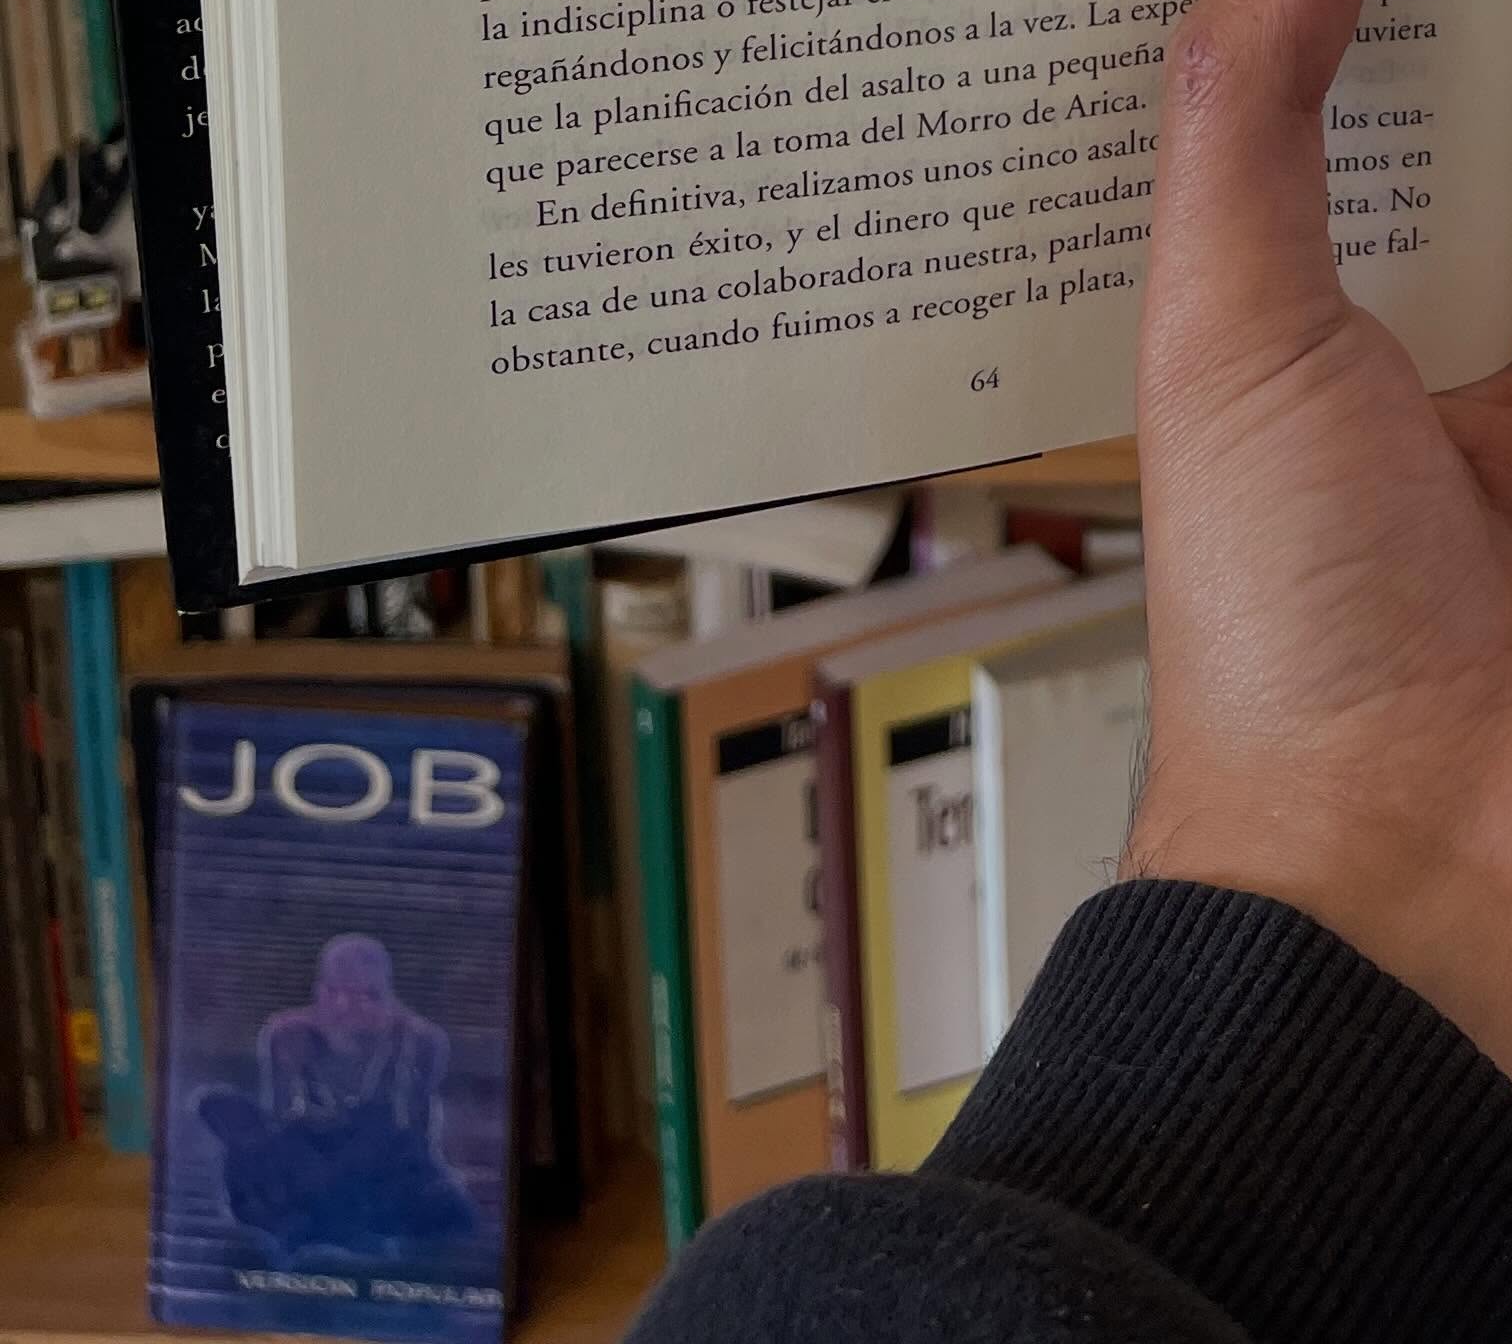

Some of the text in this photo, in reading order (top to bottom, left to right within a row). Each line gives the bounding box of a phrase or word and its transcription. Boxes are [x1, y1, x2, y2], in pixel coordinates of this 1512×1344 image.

[484, 89, 1148, 194] que parecerse a la toma del Morro de Arica.
[490, 266, 1136, 376] obstante, cuando fuimos a recoger la plata,
[969, 365, 1001, 394] 64
[177, 738, 507, 831] JOB
